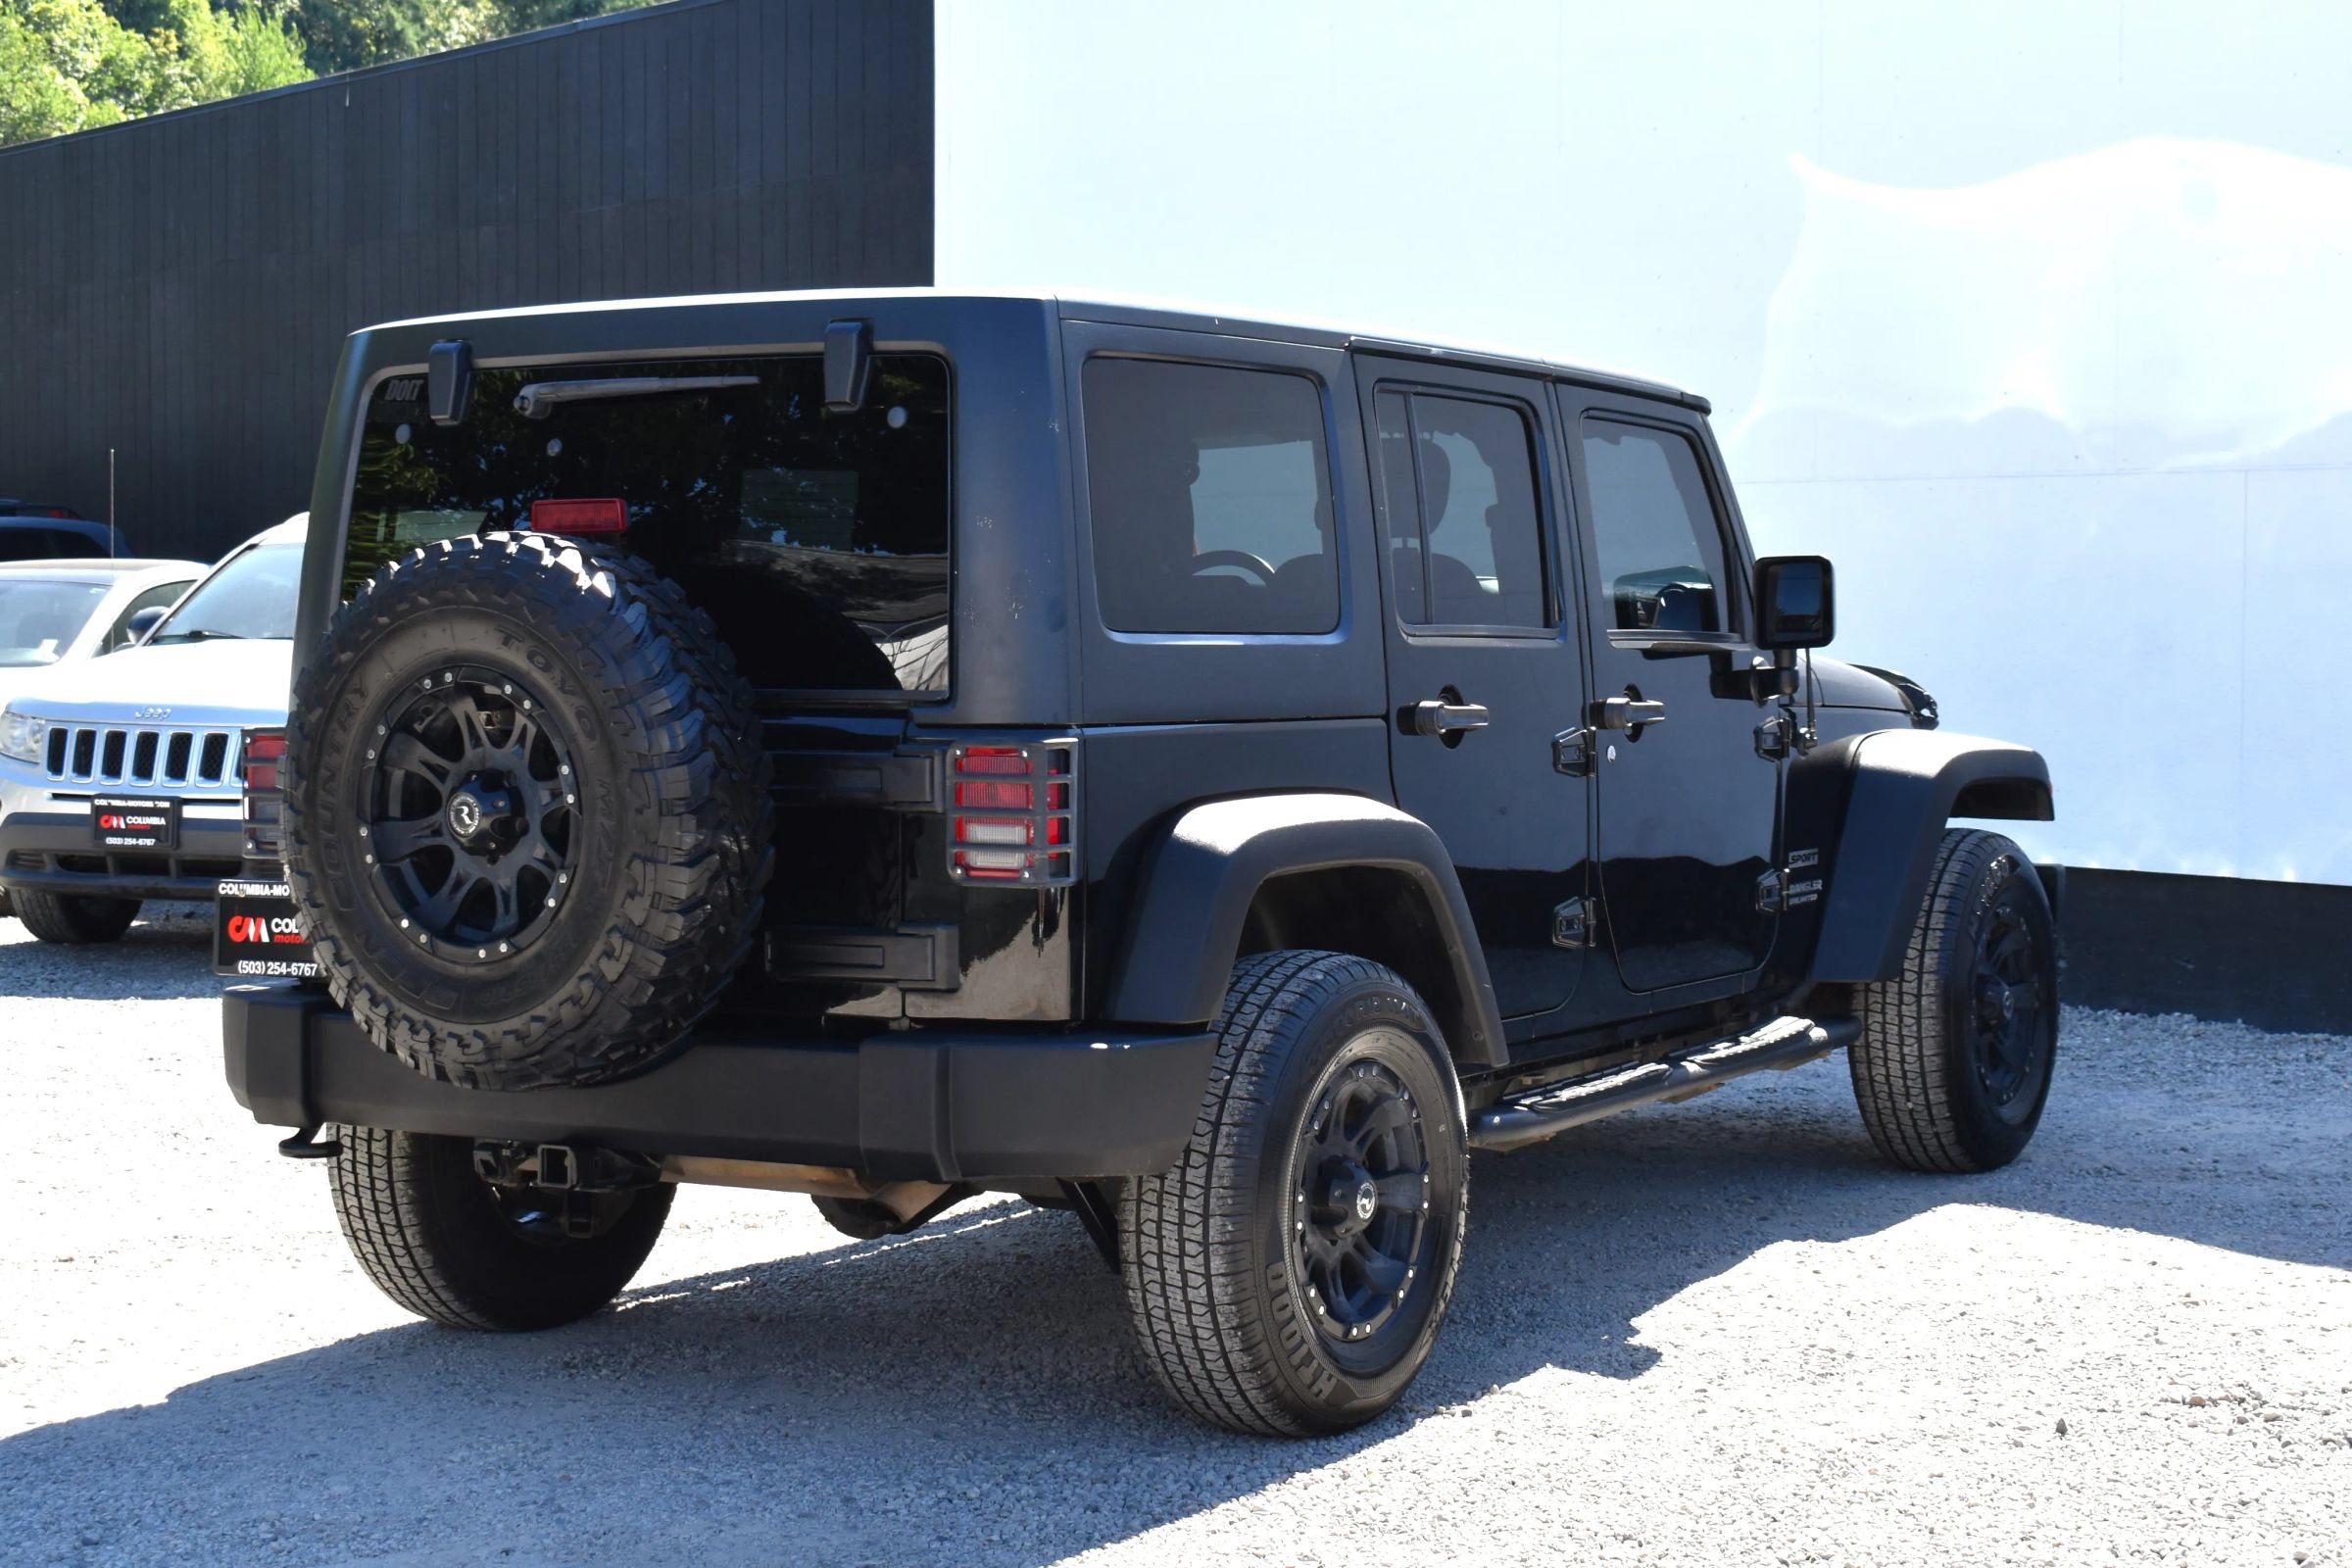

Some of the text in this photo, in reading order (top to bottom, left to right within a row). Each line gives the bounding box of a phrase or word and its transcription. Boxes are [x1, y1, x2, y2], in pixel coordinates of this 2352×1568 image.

[125, 815, 167, 825] COLUMBIA
[1790, 852, 1817, 864] SPORT
[219, 883, 291, 897] COLUMBIA-MO
[238, 960, 318, 976] (503) 254-6767
